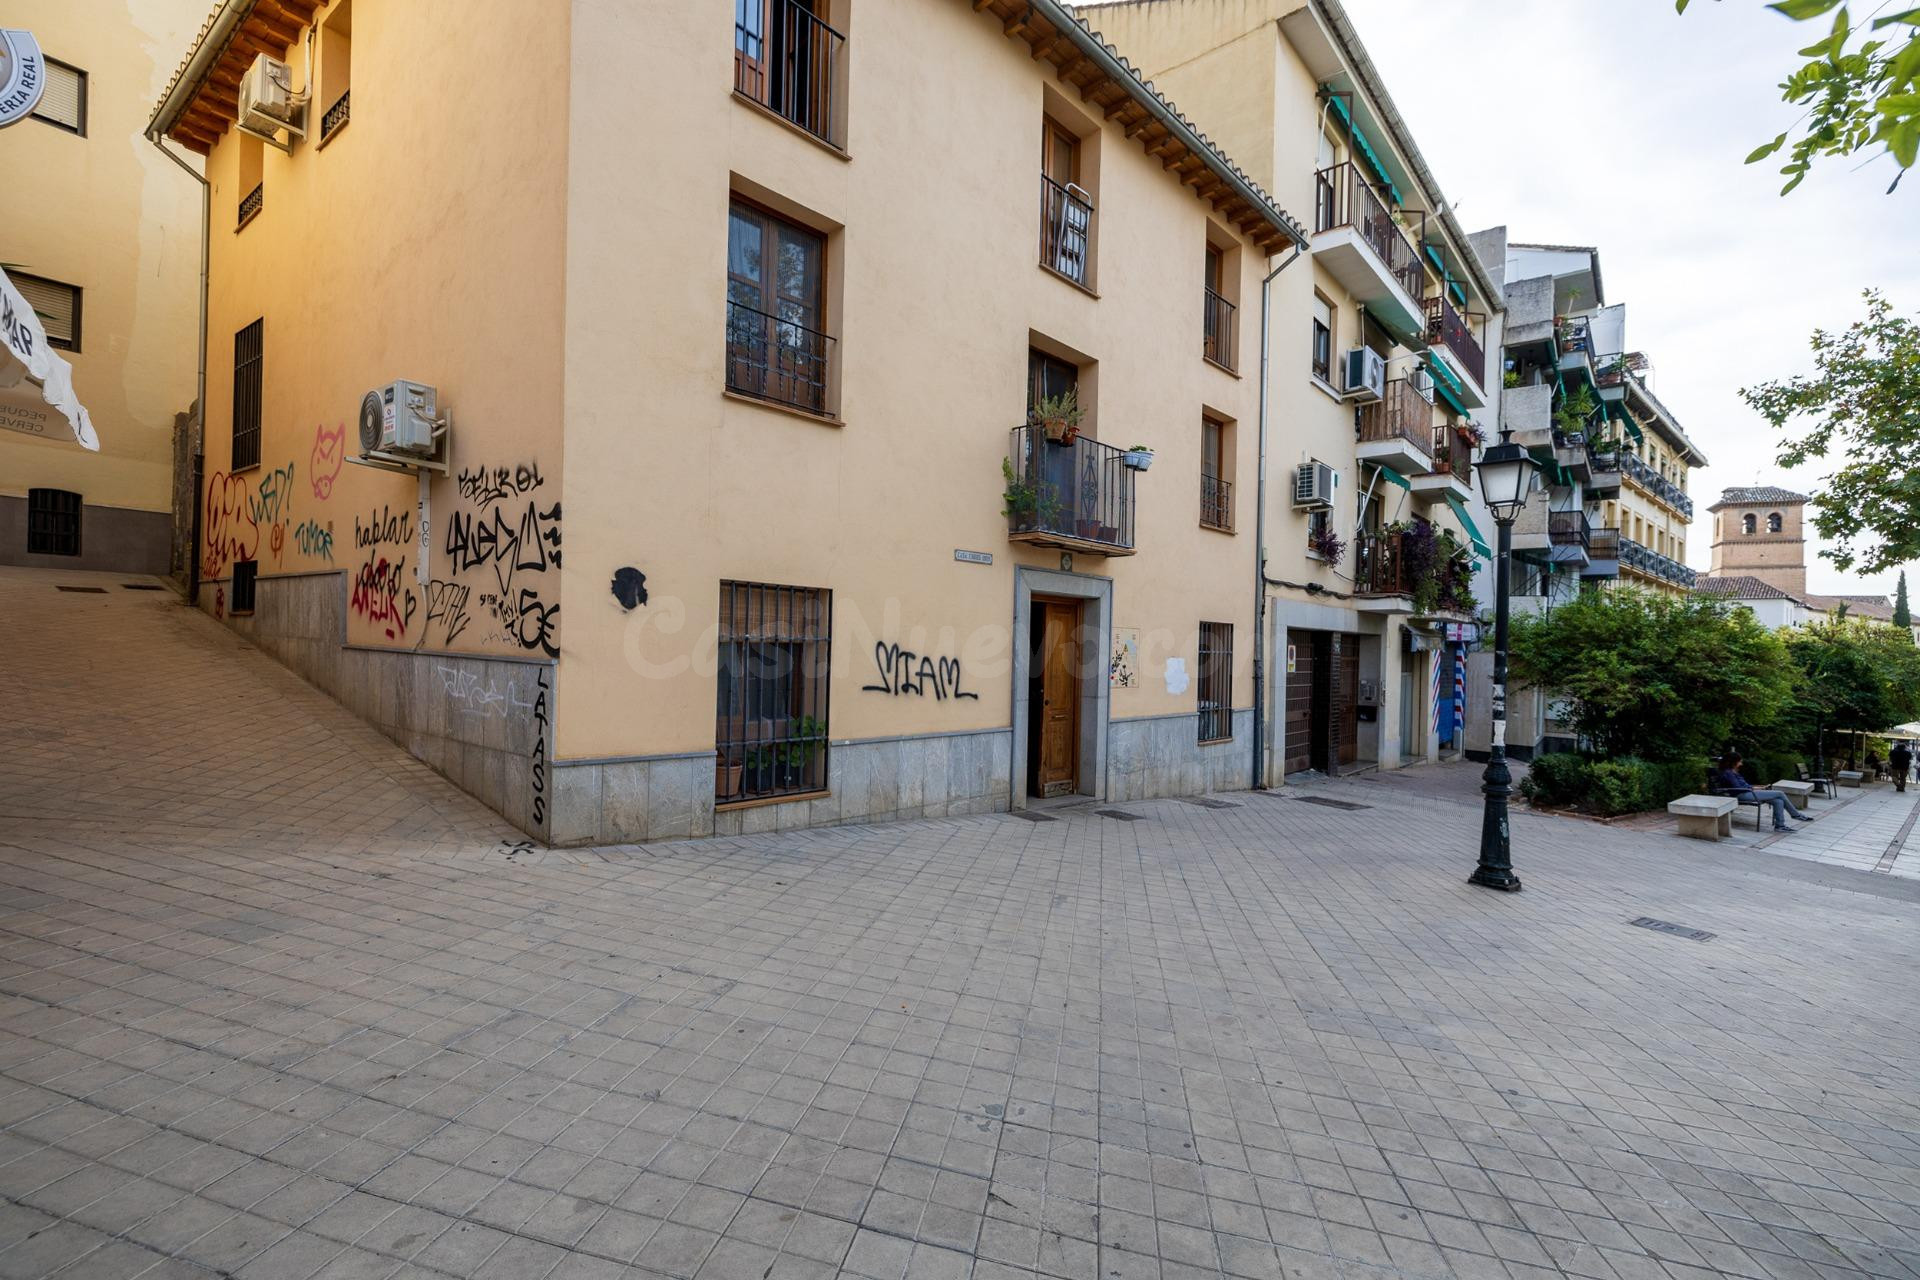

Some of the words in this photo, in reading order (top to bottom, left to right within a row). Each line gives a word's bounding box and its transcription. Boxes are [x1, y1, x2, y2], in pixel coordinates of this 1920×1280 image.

[21, 56, 36, 89] REAL
[295, 518, 335, 567] TUMOR
[355, 504, 414, 550] hablar
[862, 640, 978, 701] MIAM
[533, 667, 549, 825] LATASS
